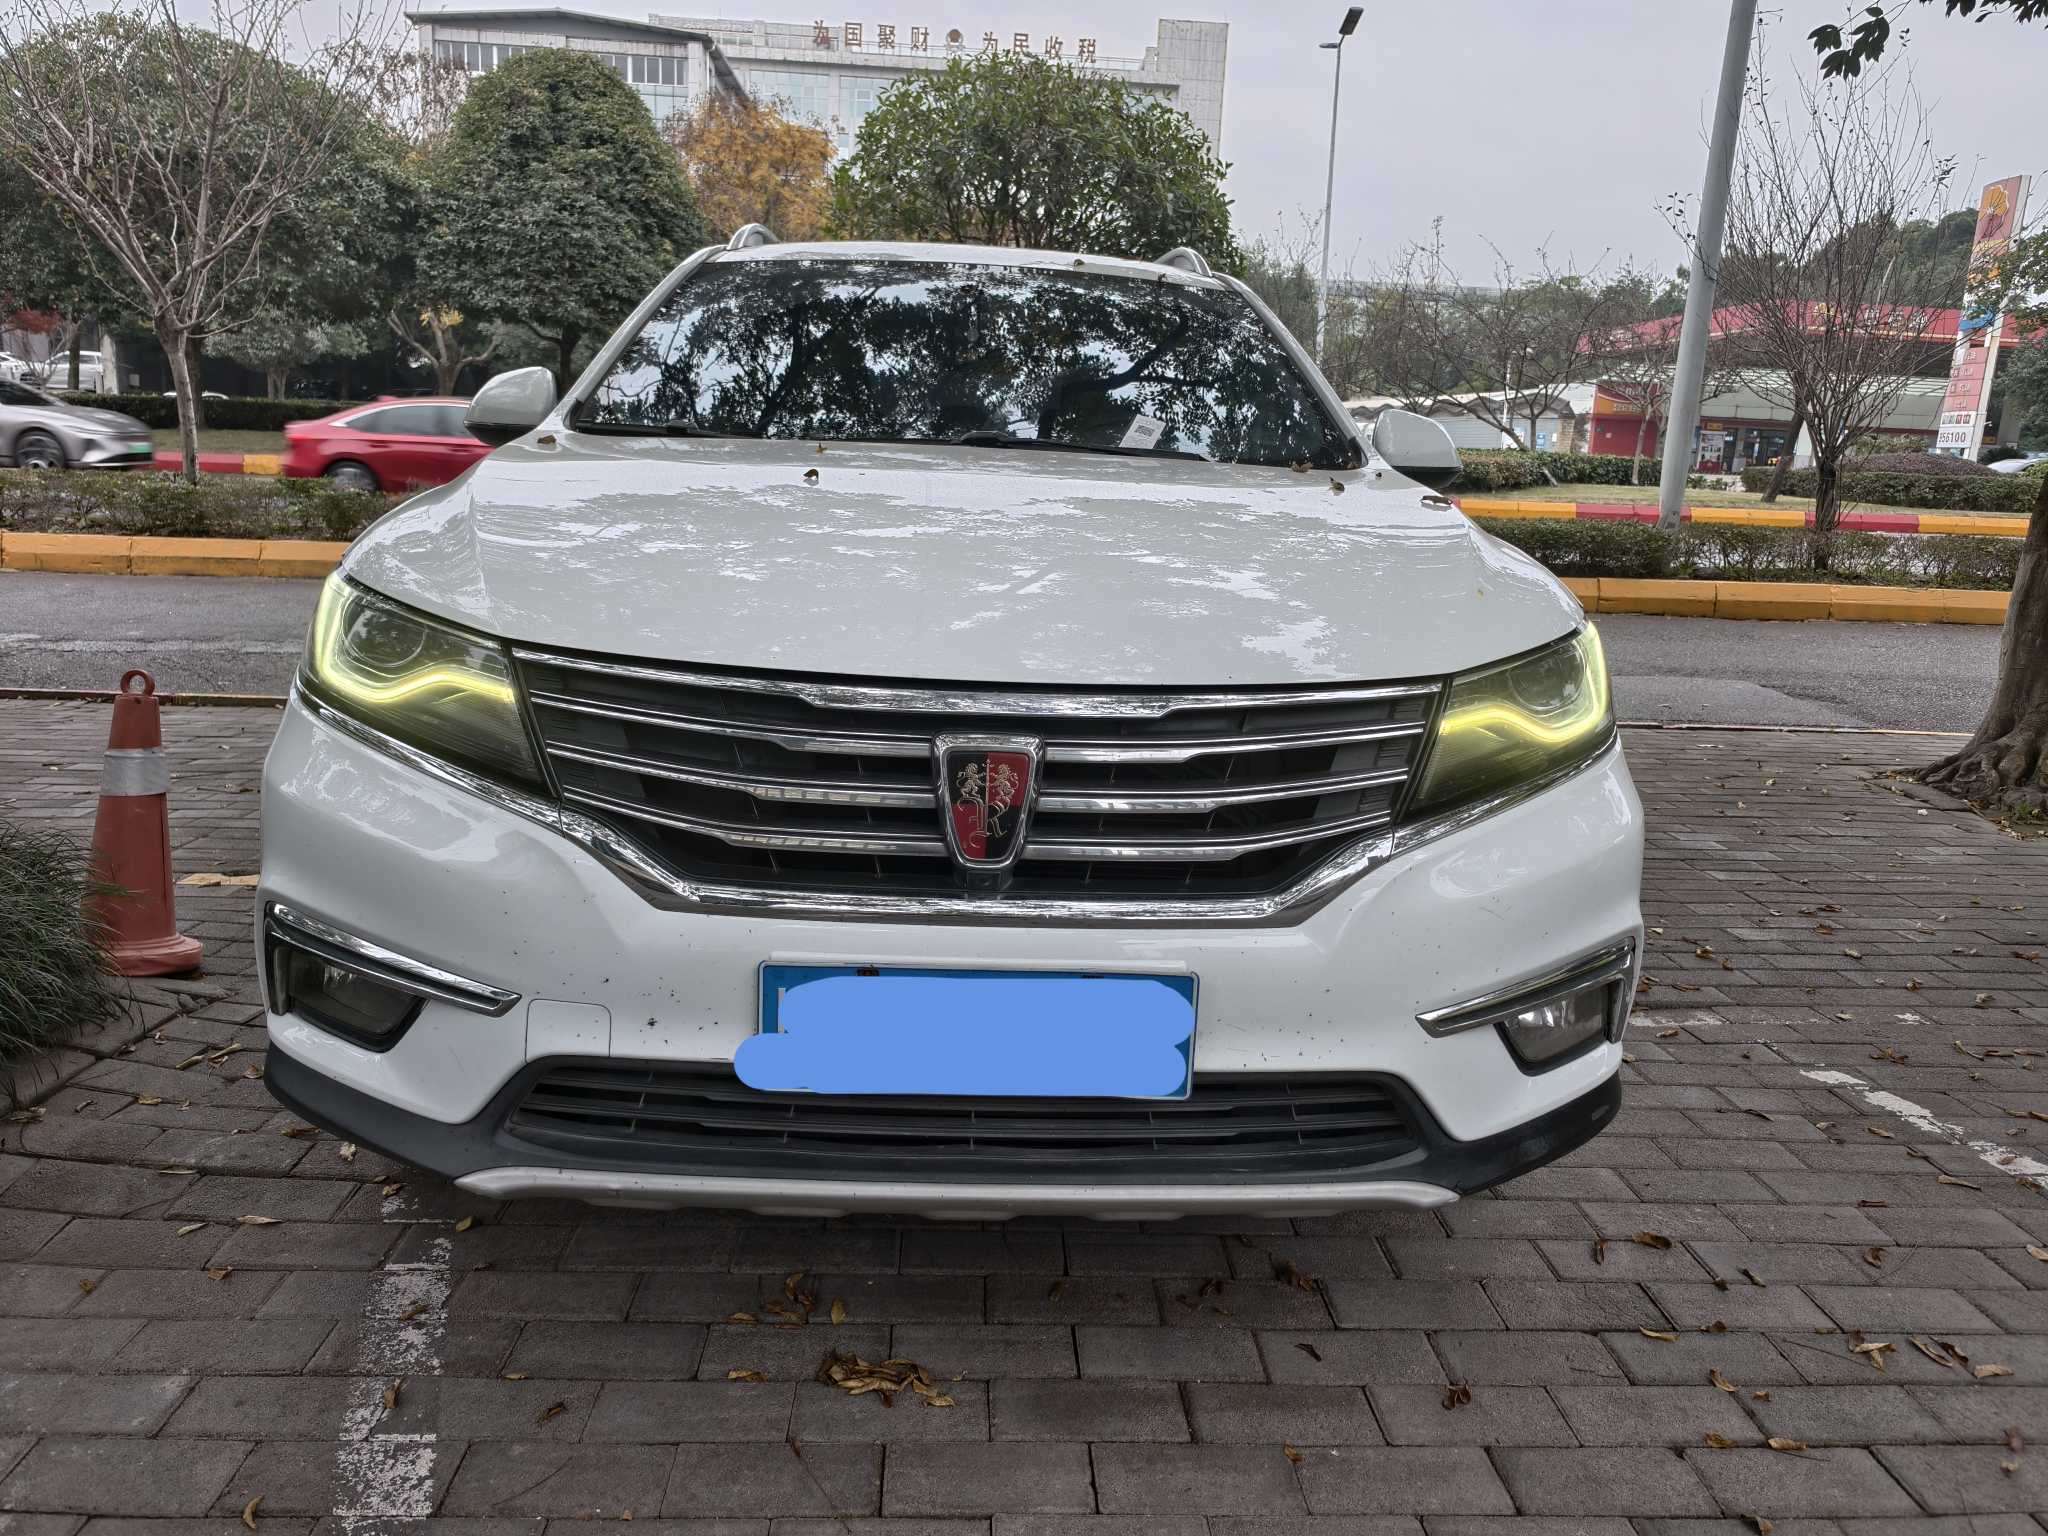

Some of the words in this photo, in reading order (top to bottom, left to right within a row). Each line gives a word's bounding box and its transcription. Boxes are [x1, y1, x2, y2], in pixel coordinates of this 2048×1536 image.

[813, 20, 929, 51] 为国聚财
[982, 31, 1097, 64] 为民收税
